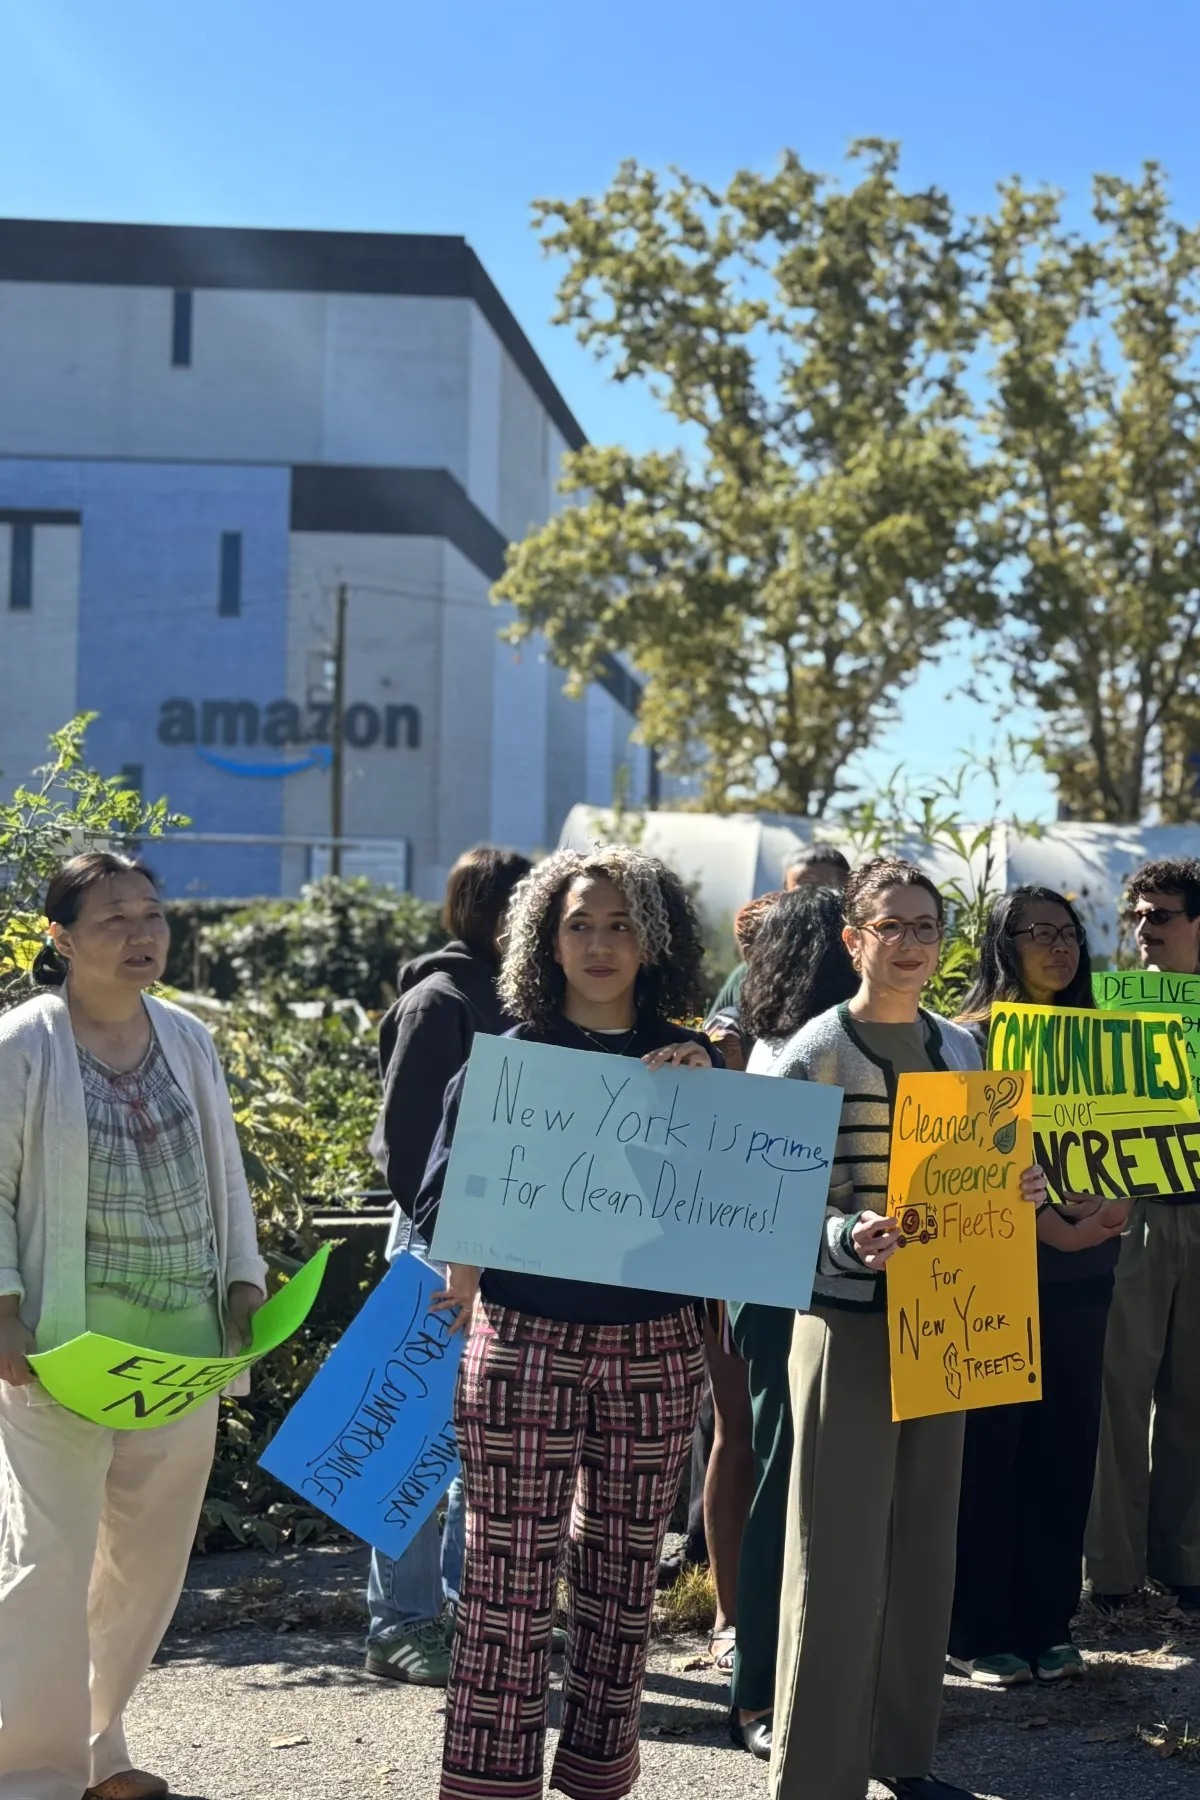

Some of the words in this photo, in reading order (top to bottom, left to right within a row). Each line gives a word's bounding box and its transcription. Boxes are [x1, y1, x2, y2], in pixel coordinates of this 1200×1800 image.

[157, 697, 422, 749] amazon
[987, 1011, 1189, 1101] COMMUNITIES
[492, 1056, 575, 1132] New
[595, 1075, 690, 1148] York
[708, 1115, 742, 1152] is
[746, 1130, 824, 1164] prime
[899, 1095, 984, 1148] Cleaner,
[1054, 1100, 1098, 1127] over
[500, 1144, 547, 1206] for
[561, 1151, 643, 1218] Clean
[651, 1159, 784, 1235] Deliveries!
[924, 1153, 1016, 1196] Greener
[943, 1200, 1015, 1244] Fleets
[931, 1257, 963, 1291] for
